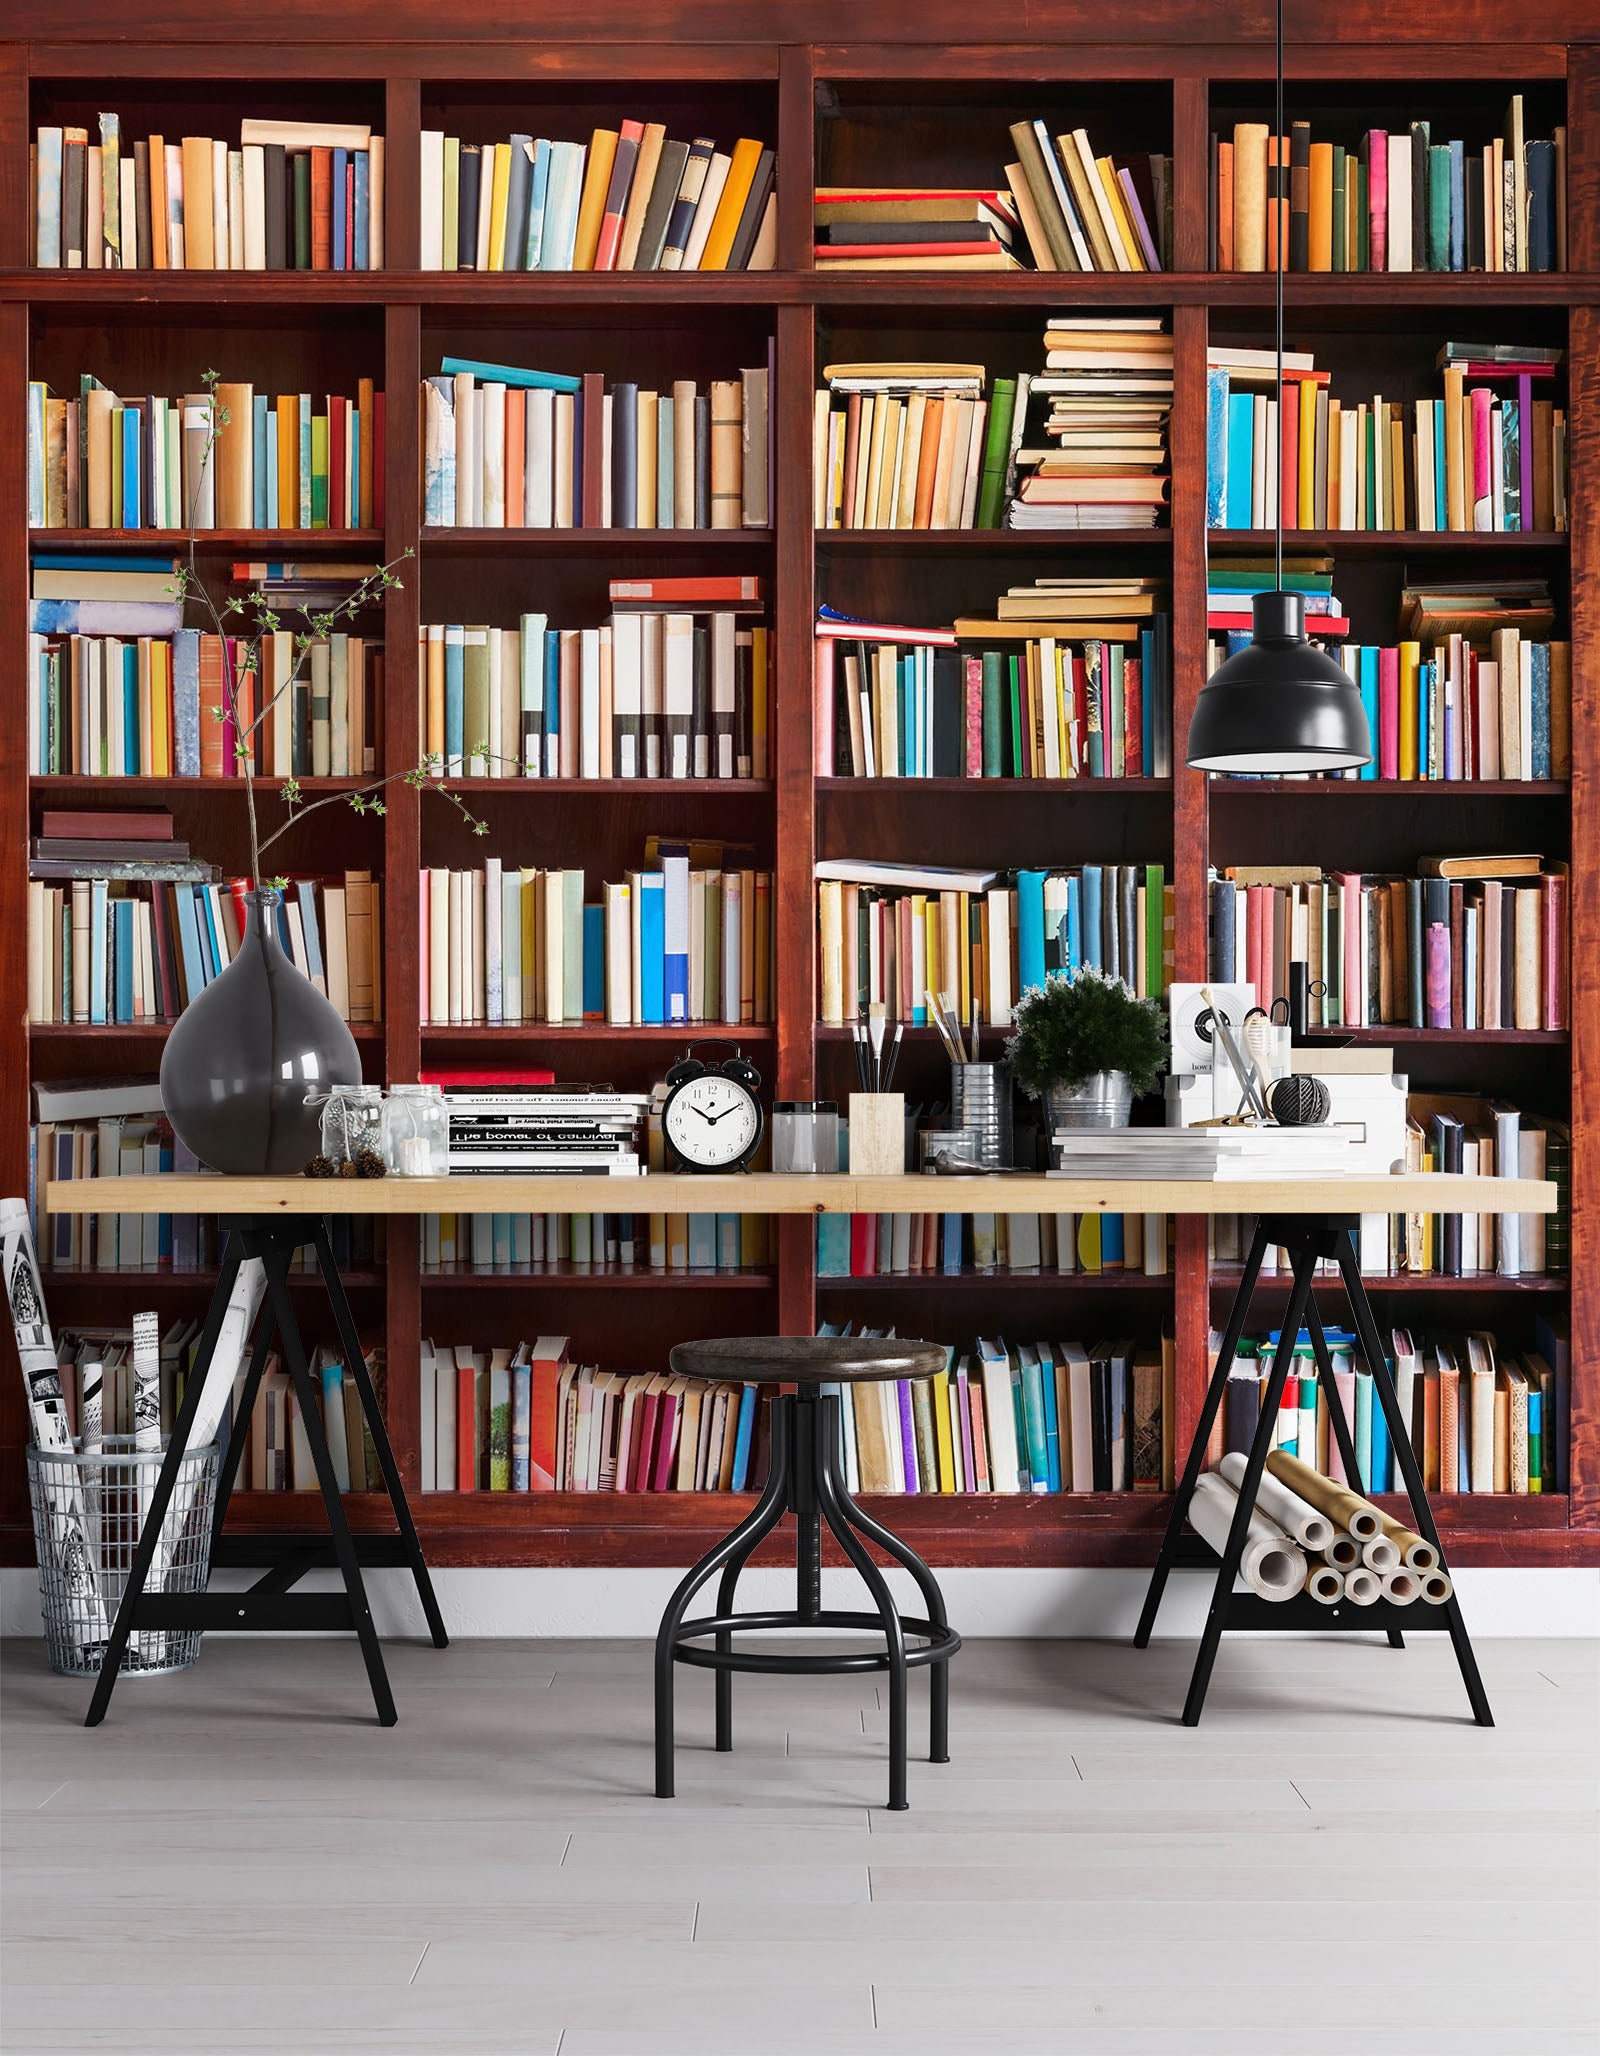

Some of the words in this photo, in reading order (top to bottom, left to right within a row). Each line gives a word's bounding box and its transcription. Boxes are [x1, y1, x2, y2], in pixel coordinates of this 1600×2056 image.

[694, 1089, 701, 1098] 11
[708, 1085, 717, 1094] 12
[727, 1089, 731, 1098] 1
[682, 1101, 691, 1110] 10
[737, 1101, 744, 1110] 2
[675, 1117, 682, 1126] 9
[743, 1117, 749, 1126] 3
[680, 1133, 687, 1142] 8
[738, 1133, 743, 1142] 4
[693, 1143, 699, 1153] 7
[726, 1143, 733, 1153] 5
[708, 1148, 716, 1158] 6
